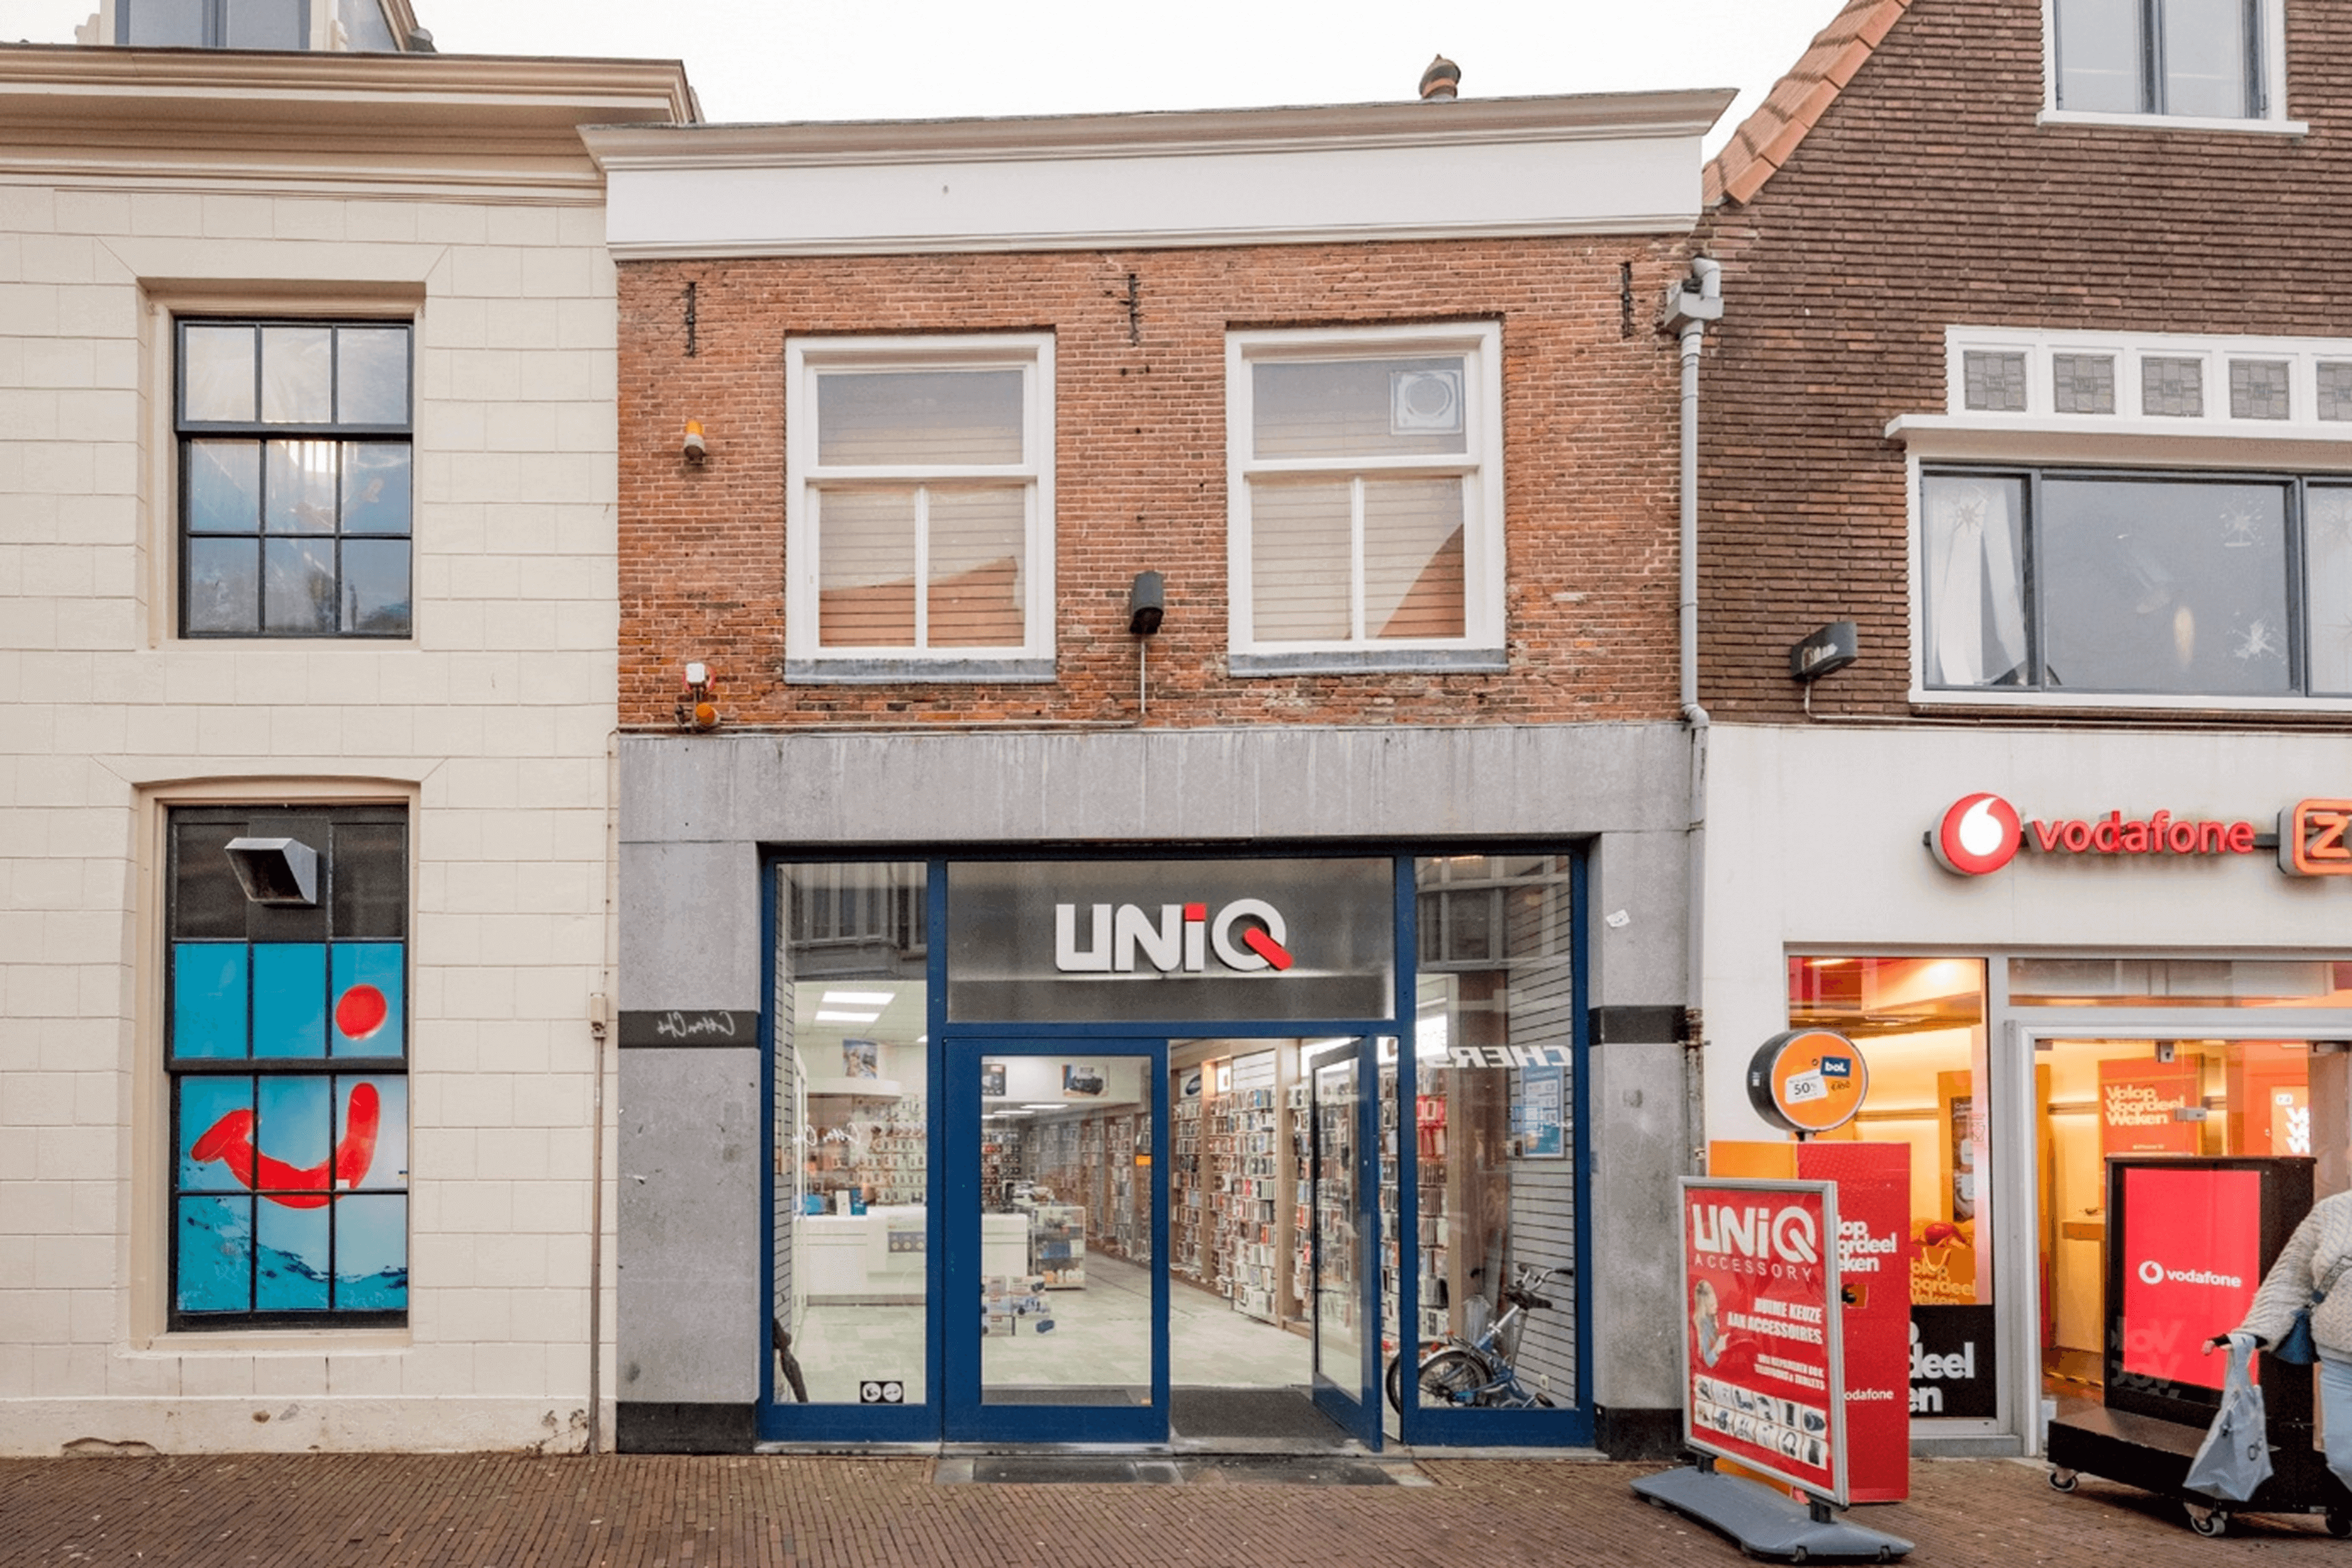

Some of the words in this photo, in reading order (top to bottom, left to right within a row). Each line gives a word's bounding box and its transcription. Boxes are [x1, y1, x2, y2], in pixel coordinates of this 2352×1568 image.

[2032, 809, 2255, 853] vodafone
[2105, 1084, 2157, 1102] Volop
[2105, 1095, 2186, 1111] Voordeel
[2105, 1109, 2169, 1126] Weken
[1838, 1232, 1898, 1253] ordeel
[1694, 1254, 1812, 1282] ACCESSORY
[2166, 1269, 2242, 1288] vodafone
[1789, 1303, 1822, 1324] KEUZE
[1844, 1387, 1894, 1401] odafone
